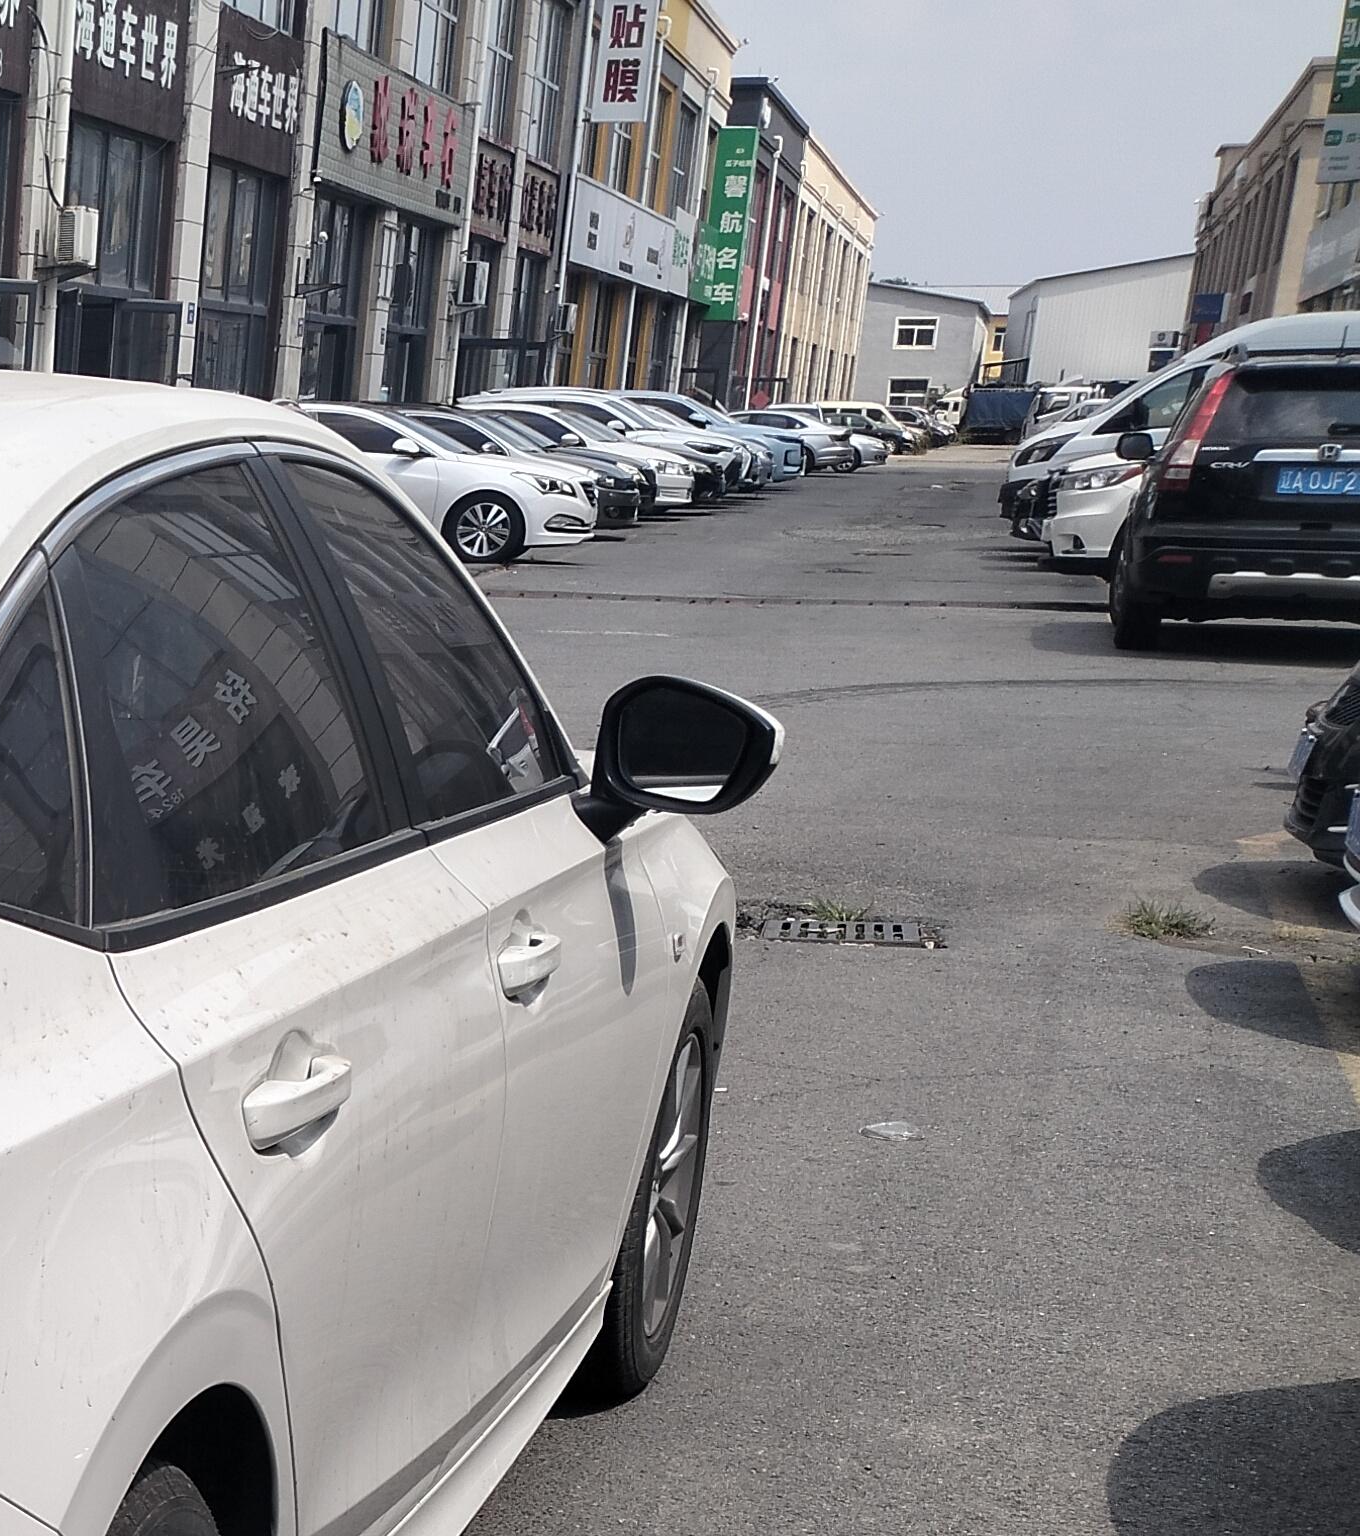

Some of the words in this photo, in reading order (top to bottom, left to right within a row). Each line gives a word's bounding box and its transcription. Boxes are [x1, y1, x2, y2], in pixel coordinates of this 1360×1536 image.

[230, 51, 300, 135] 海通车世界
[602, 4, 648, 103] 贴膜
[710, 175, 749, 305] 馨航名车
